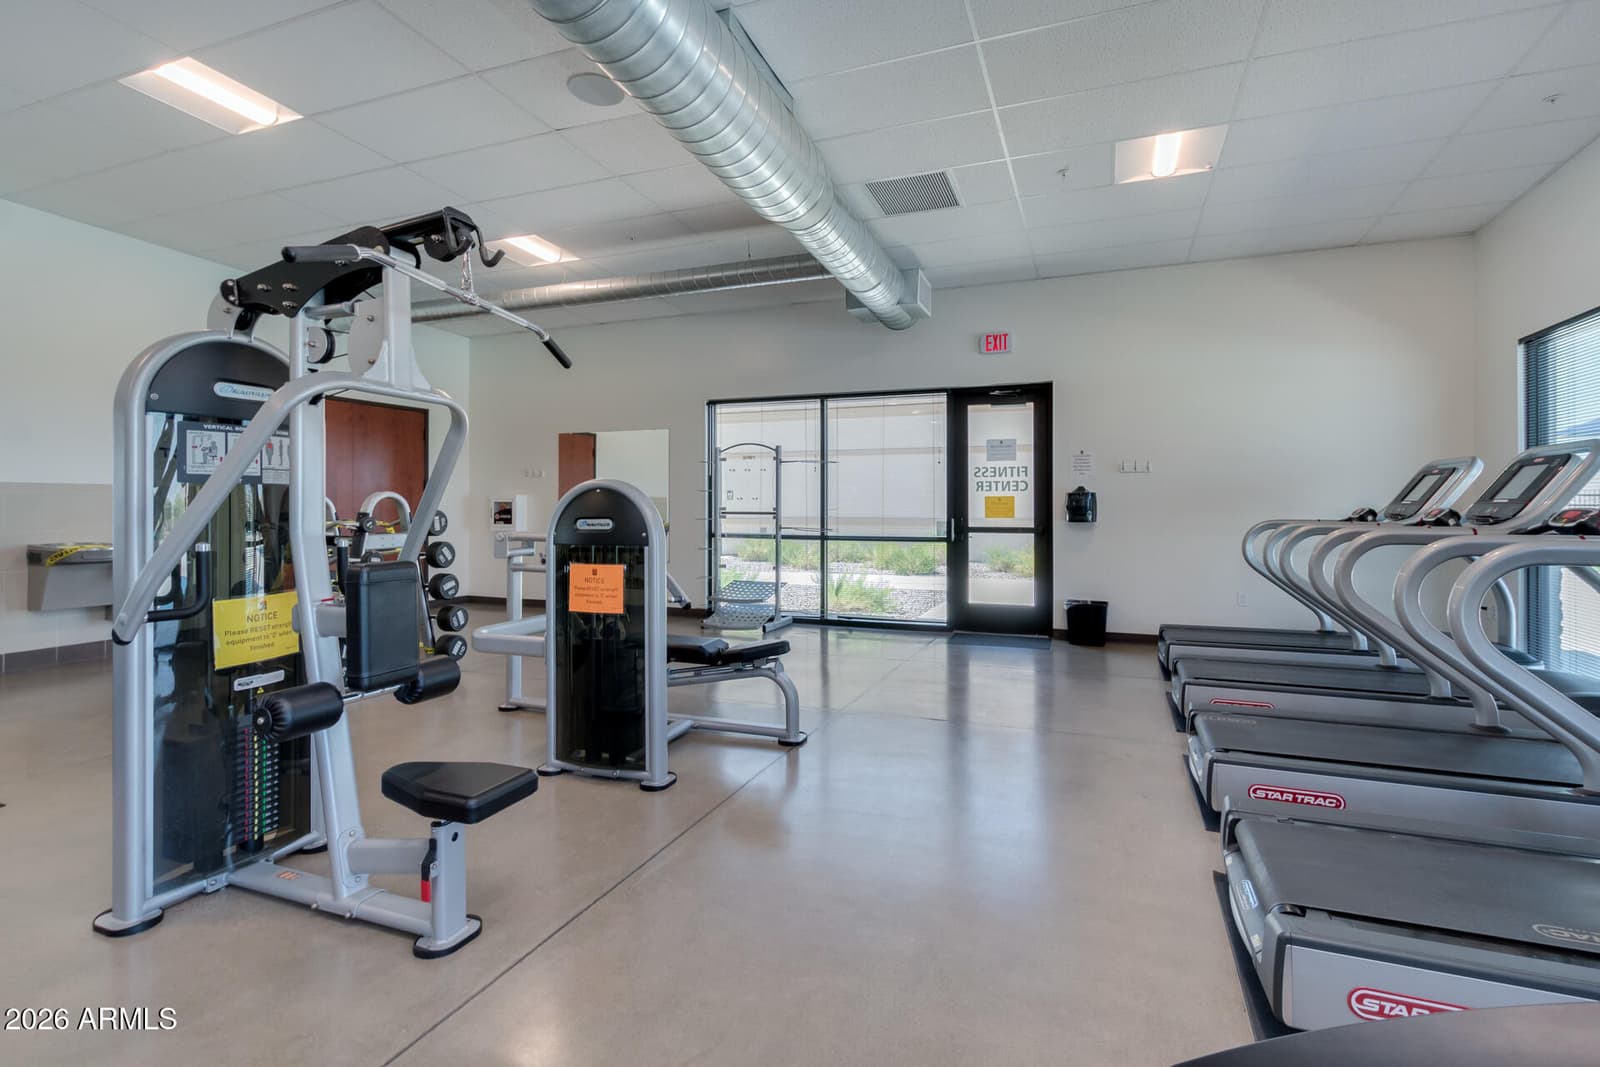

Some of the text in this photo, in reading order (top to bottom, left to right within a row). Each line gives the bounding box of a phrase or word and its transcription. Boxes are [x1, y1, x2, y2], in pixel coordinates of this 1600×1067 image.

[985, 333, 1008, 352] EXIT
[203, 423, 233, 431] VERTICAL
[246, 611, 279, 623] NOTICE
[224, 627, 249, 636] Please
[226, 635, 262, 646] equipment
[1256, 789, 1337, 807] STAR TRAC
